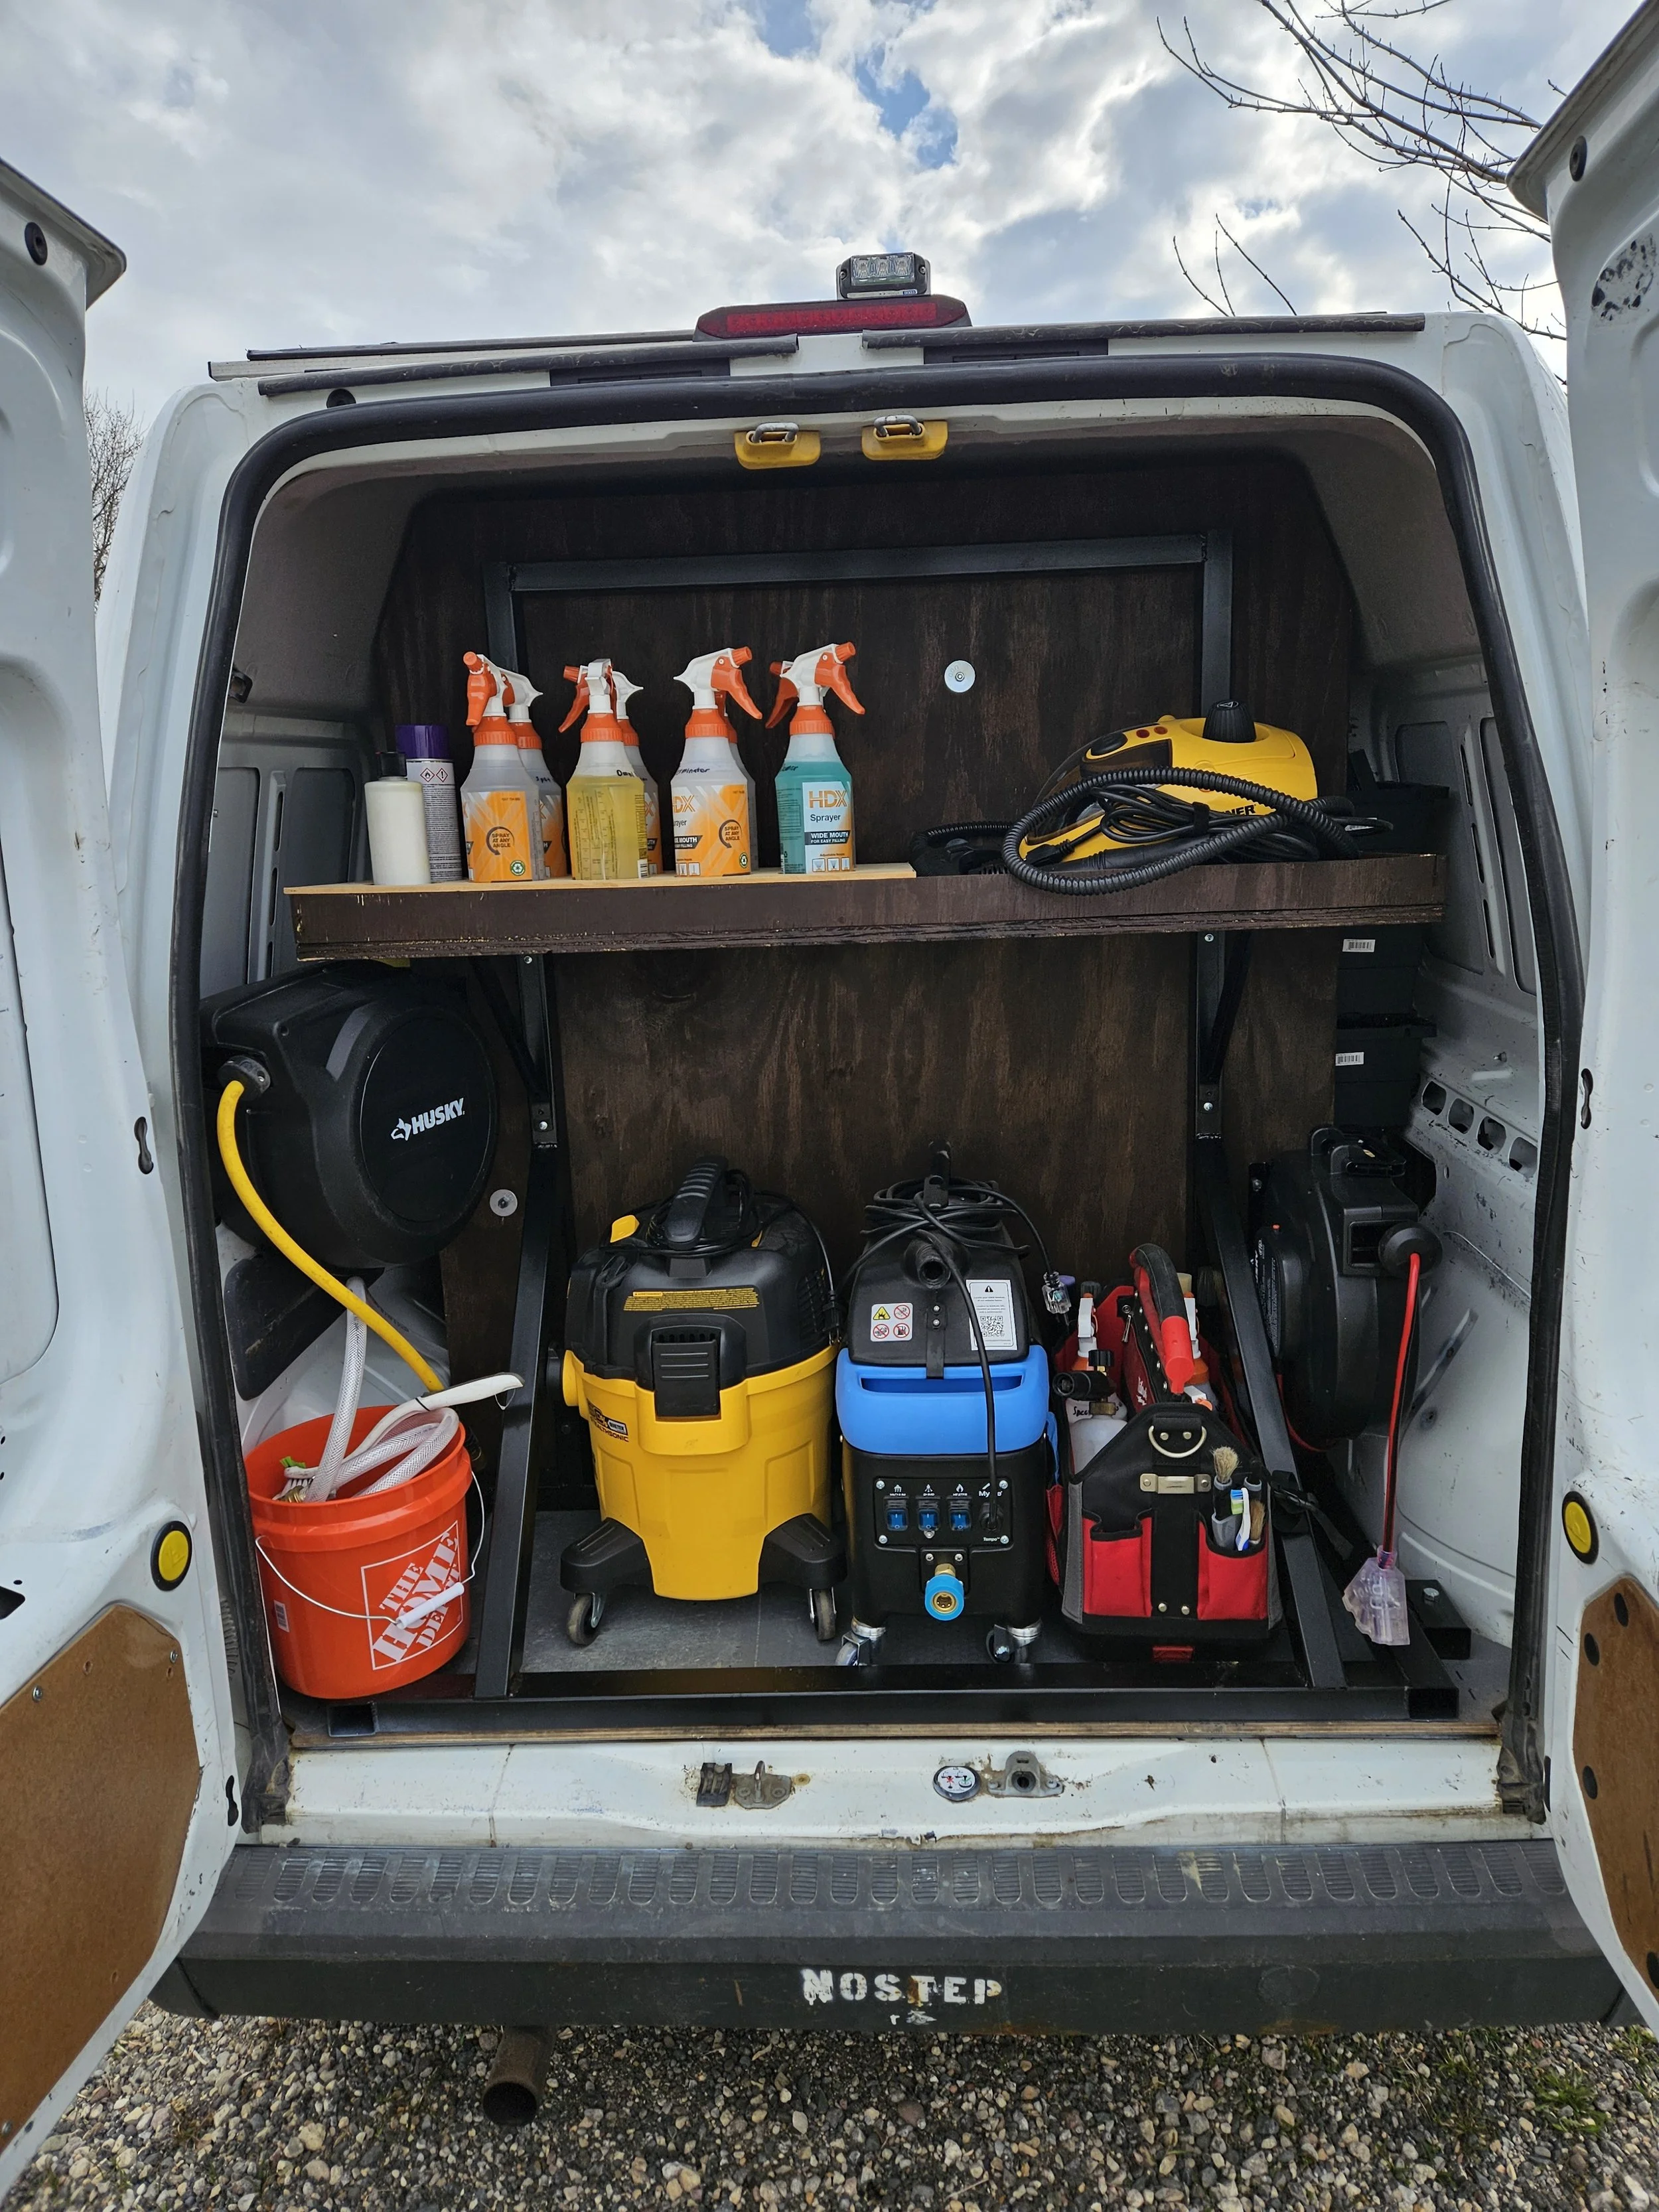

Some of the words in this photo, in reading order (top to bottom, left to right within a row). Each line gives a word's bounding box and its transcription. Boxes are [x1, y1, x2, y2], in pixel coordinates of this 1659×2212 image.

[808, 790, 847, 808] HDX
[810, 814, 841, 823] Sprayer
[1224, 804, 1256, 815] NER
[411, 1098, 464, 1135] HUSKY
[378, 1562, 425, 1612] THE
